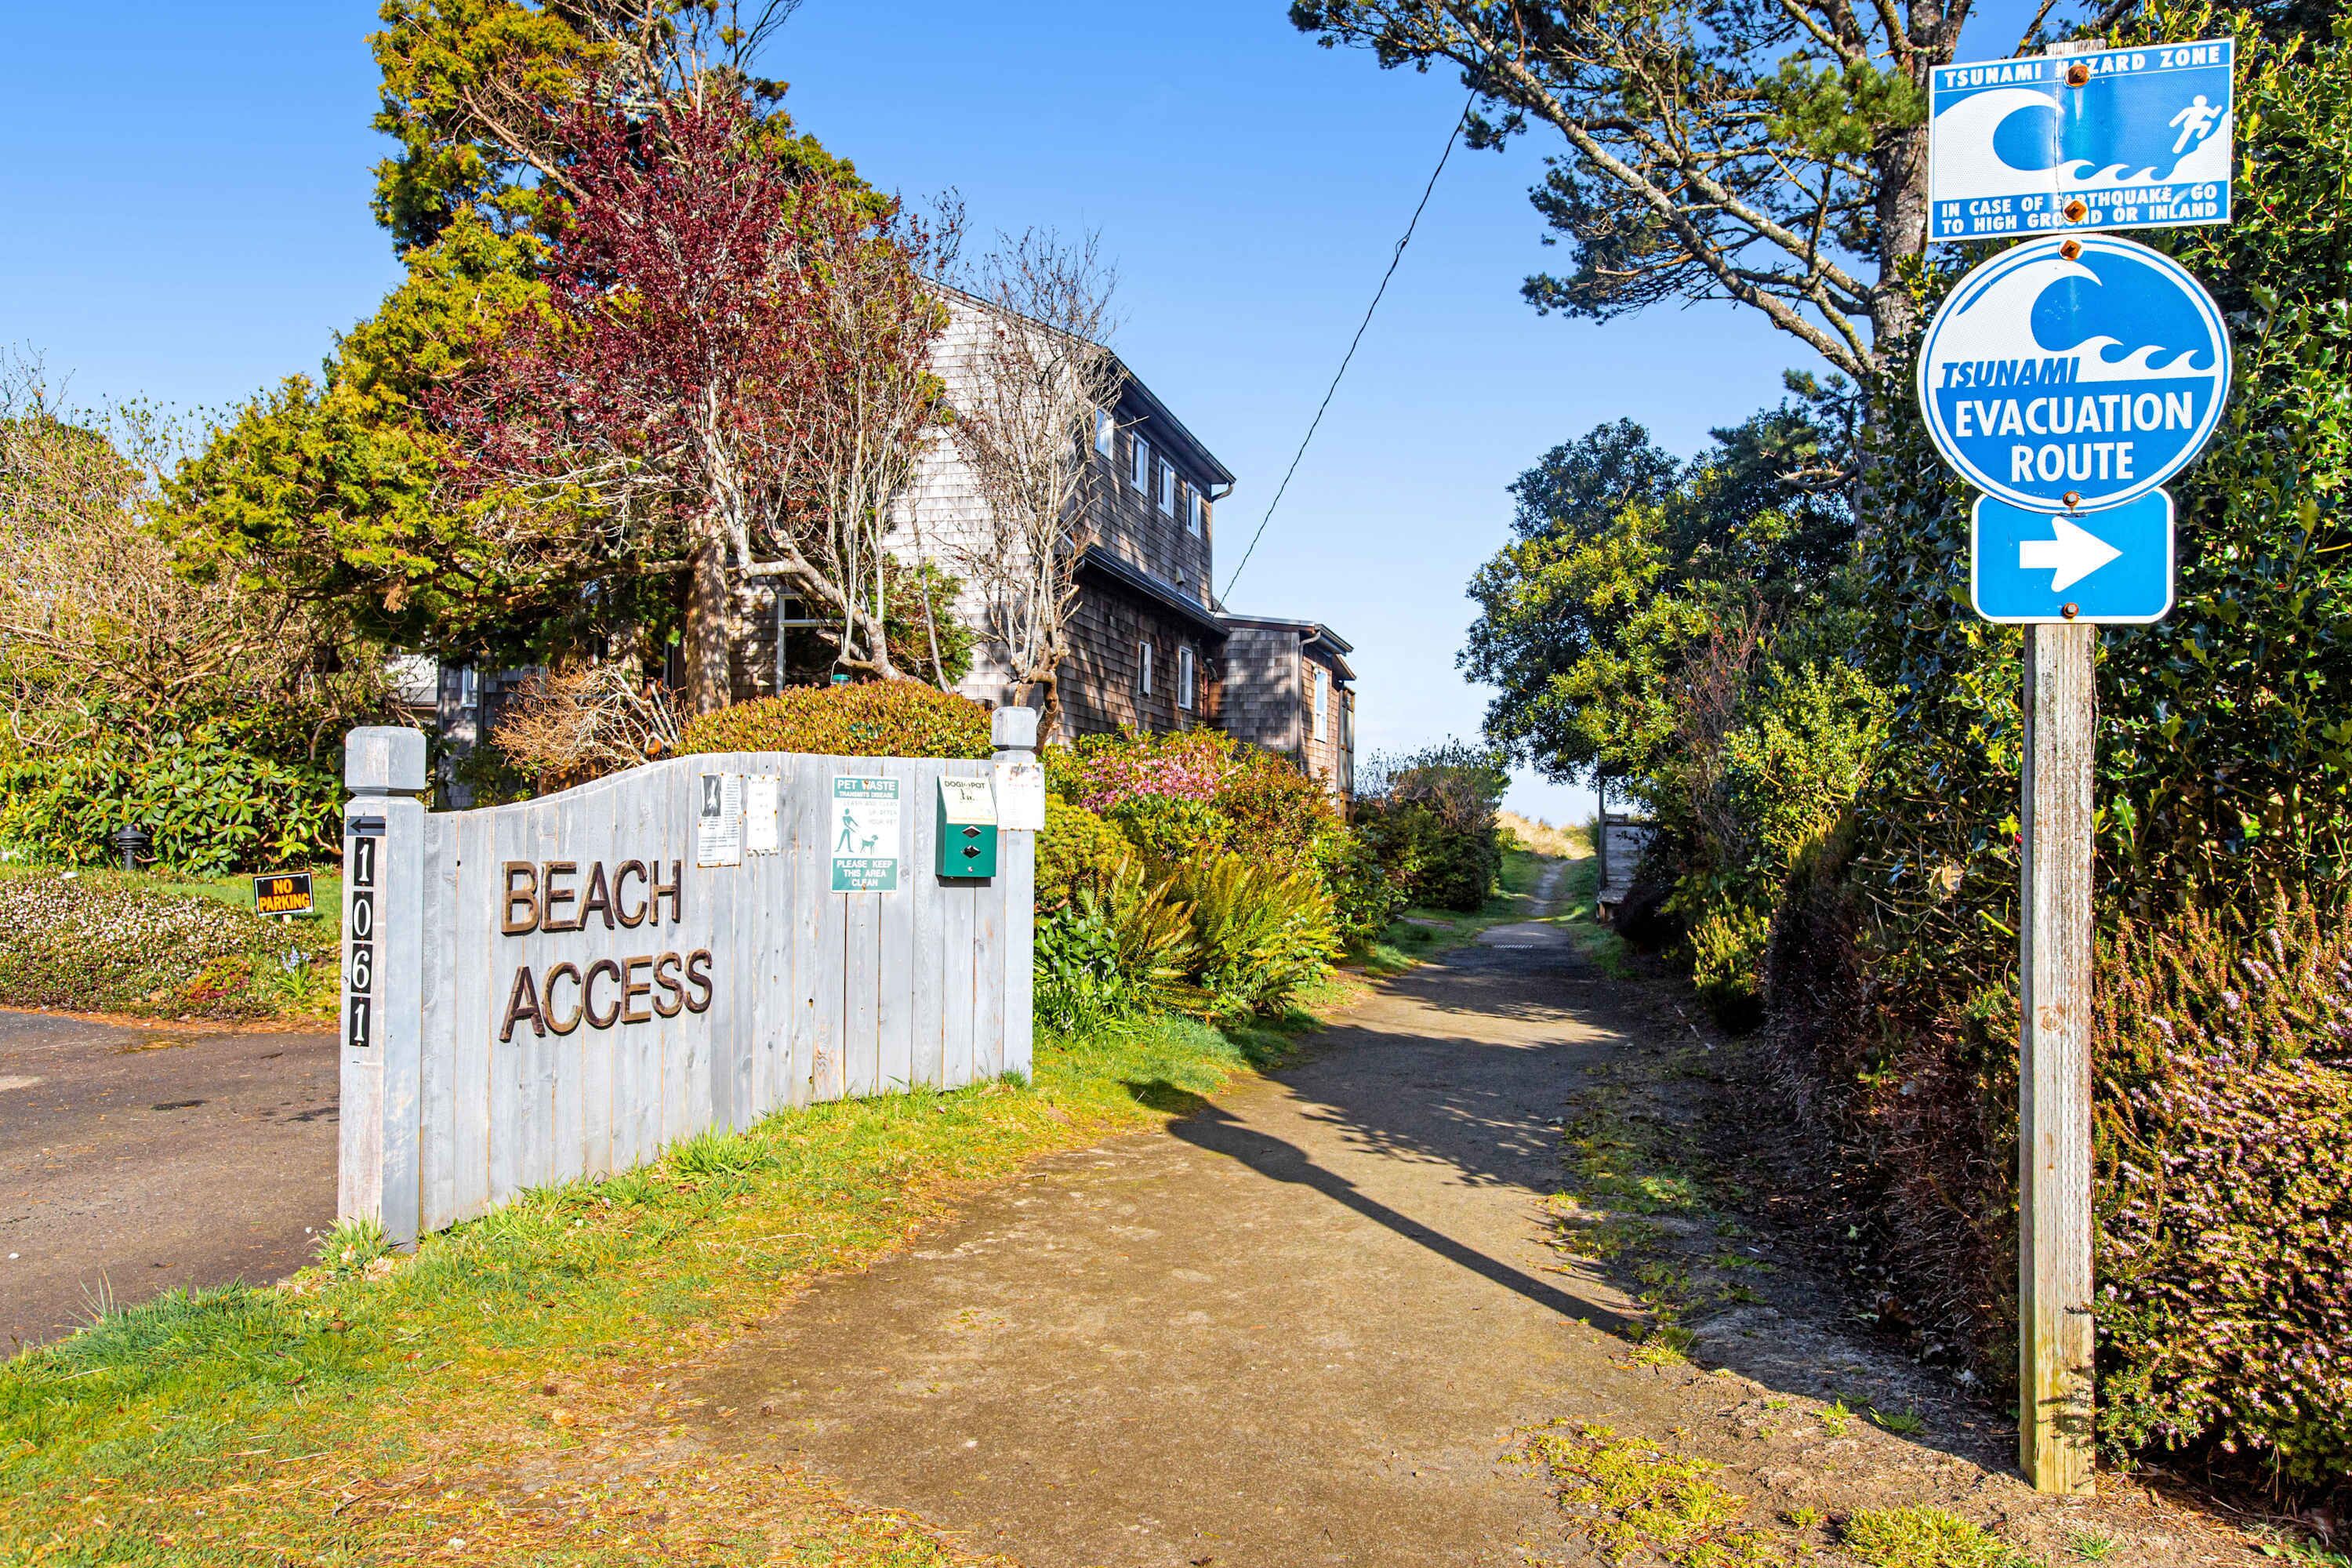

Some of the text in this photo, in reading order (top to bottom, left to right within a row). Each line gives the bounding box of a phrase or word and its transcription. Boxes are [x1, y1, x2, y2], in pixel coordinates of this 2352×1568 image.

[1944, 45, 2220, 88] TSUNAMI HZARD ZONE
[1941, 201, 1959, 218] IN
[1969, 199, 2012, 216] CASE
[2021, 197, 2043, 212] OF
[2190, 184, 2217, 201] GO
[1941, 201, 2217, 234] TO HIGH GROND OR INLAND
[1942, 357, 2080, 388] TSUNAMI
[1955, 392, 2192, 437] EVACUATION
[2012, 442, 2133, 483] ROUTE
[837, 779, 895, 791] PET WASTE
[837, 859, 892, 868] PLEASE KEEP
[843, 869, 886, 877] THIS AREA
[272, 878, 293, 895] NO
[501, 859, 681, 936] BEACH
[851, 878, 878, 887] CLEAN
[258, 892, 310, 913] PARKING
[351, 844, 372, 1041] 1061
[499, 949, 713, 1044] ACCESS
